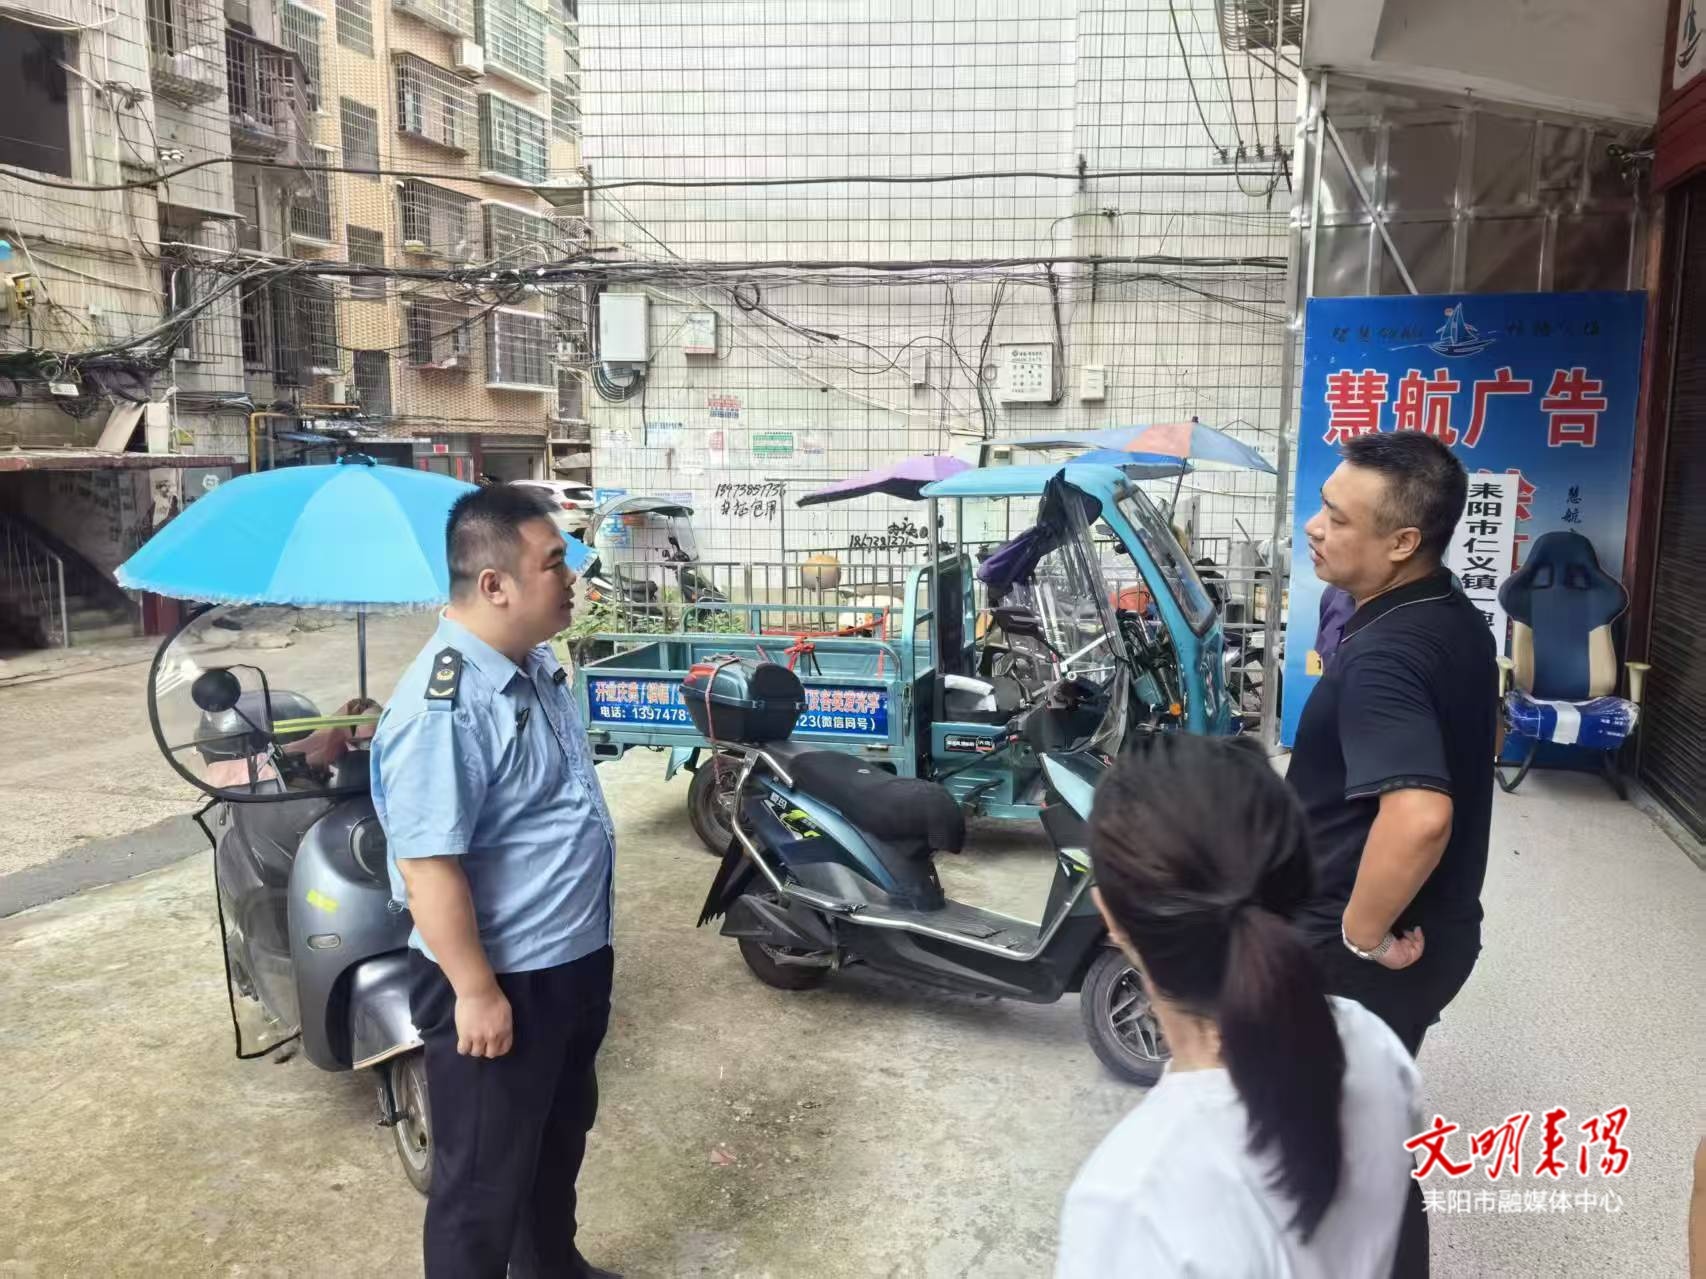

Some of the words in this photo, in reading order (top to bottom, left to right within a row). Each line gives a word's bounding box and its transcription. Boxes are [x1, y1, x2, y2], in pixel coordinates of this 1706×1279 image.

[1323, 366, 1607, 448] 慧航广告
[1561, 485, 1583, 532] 慧航
